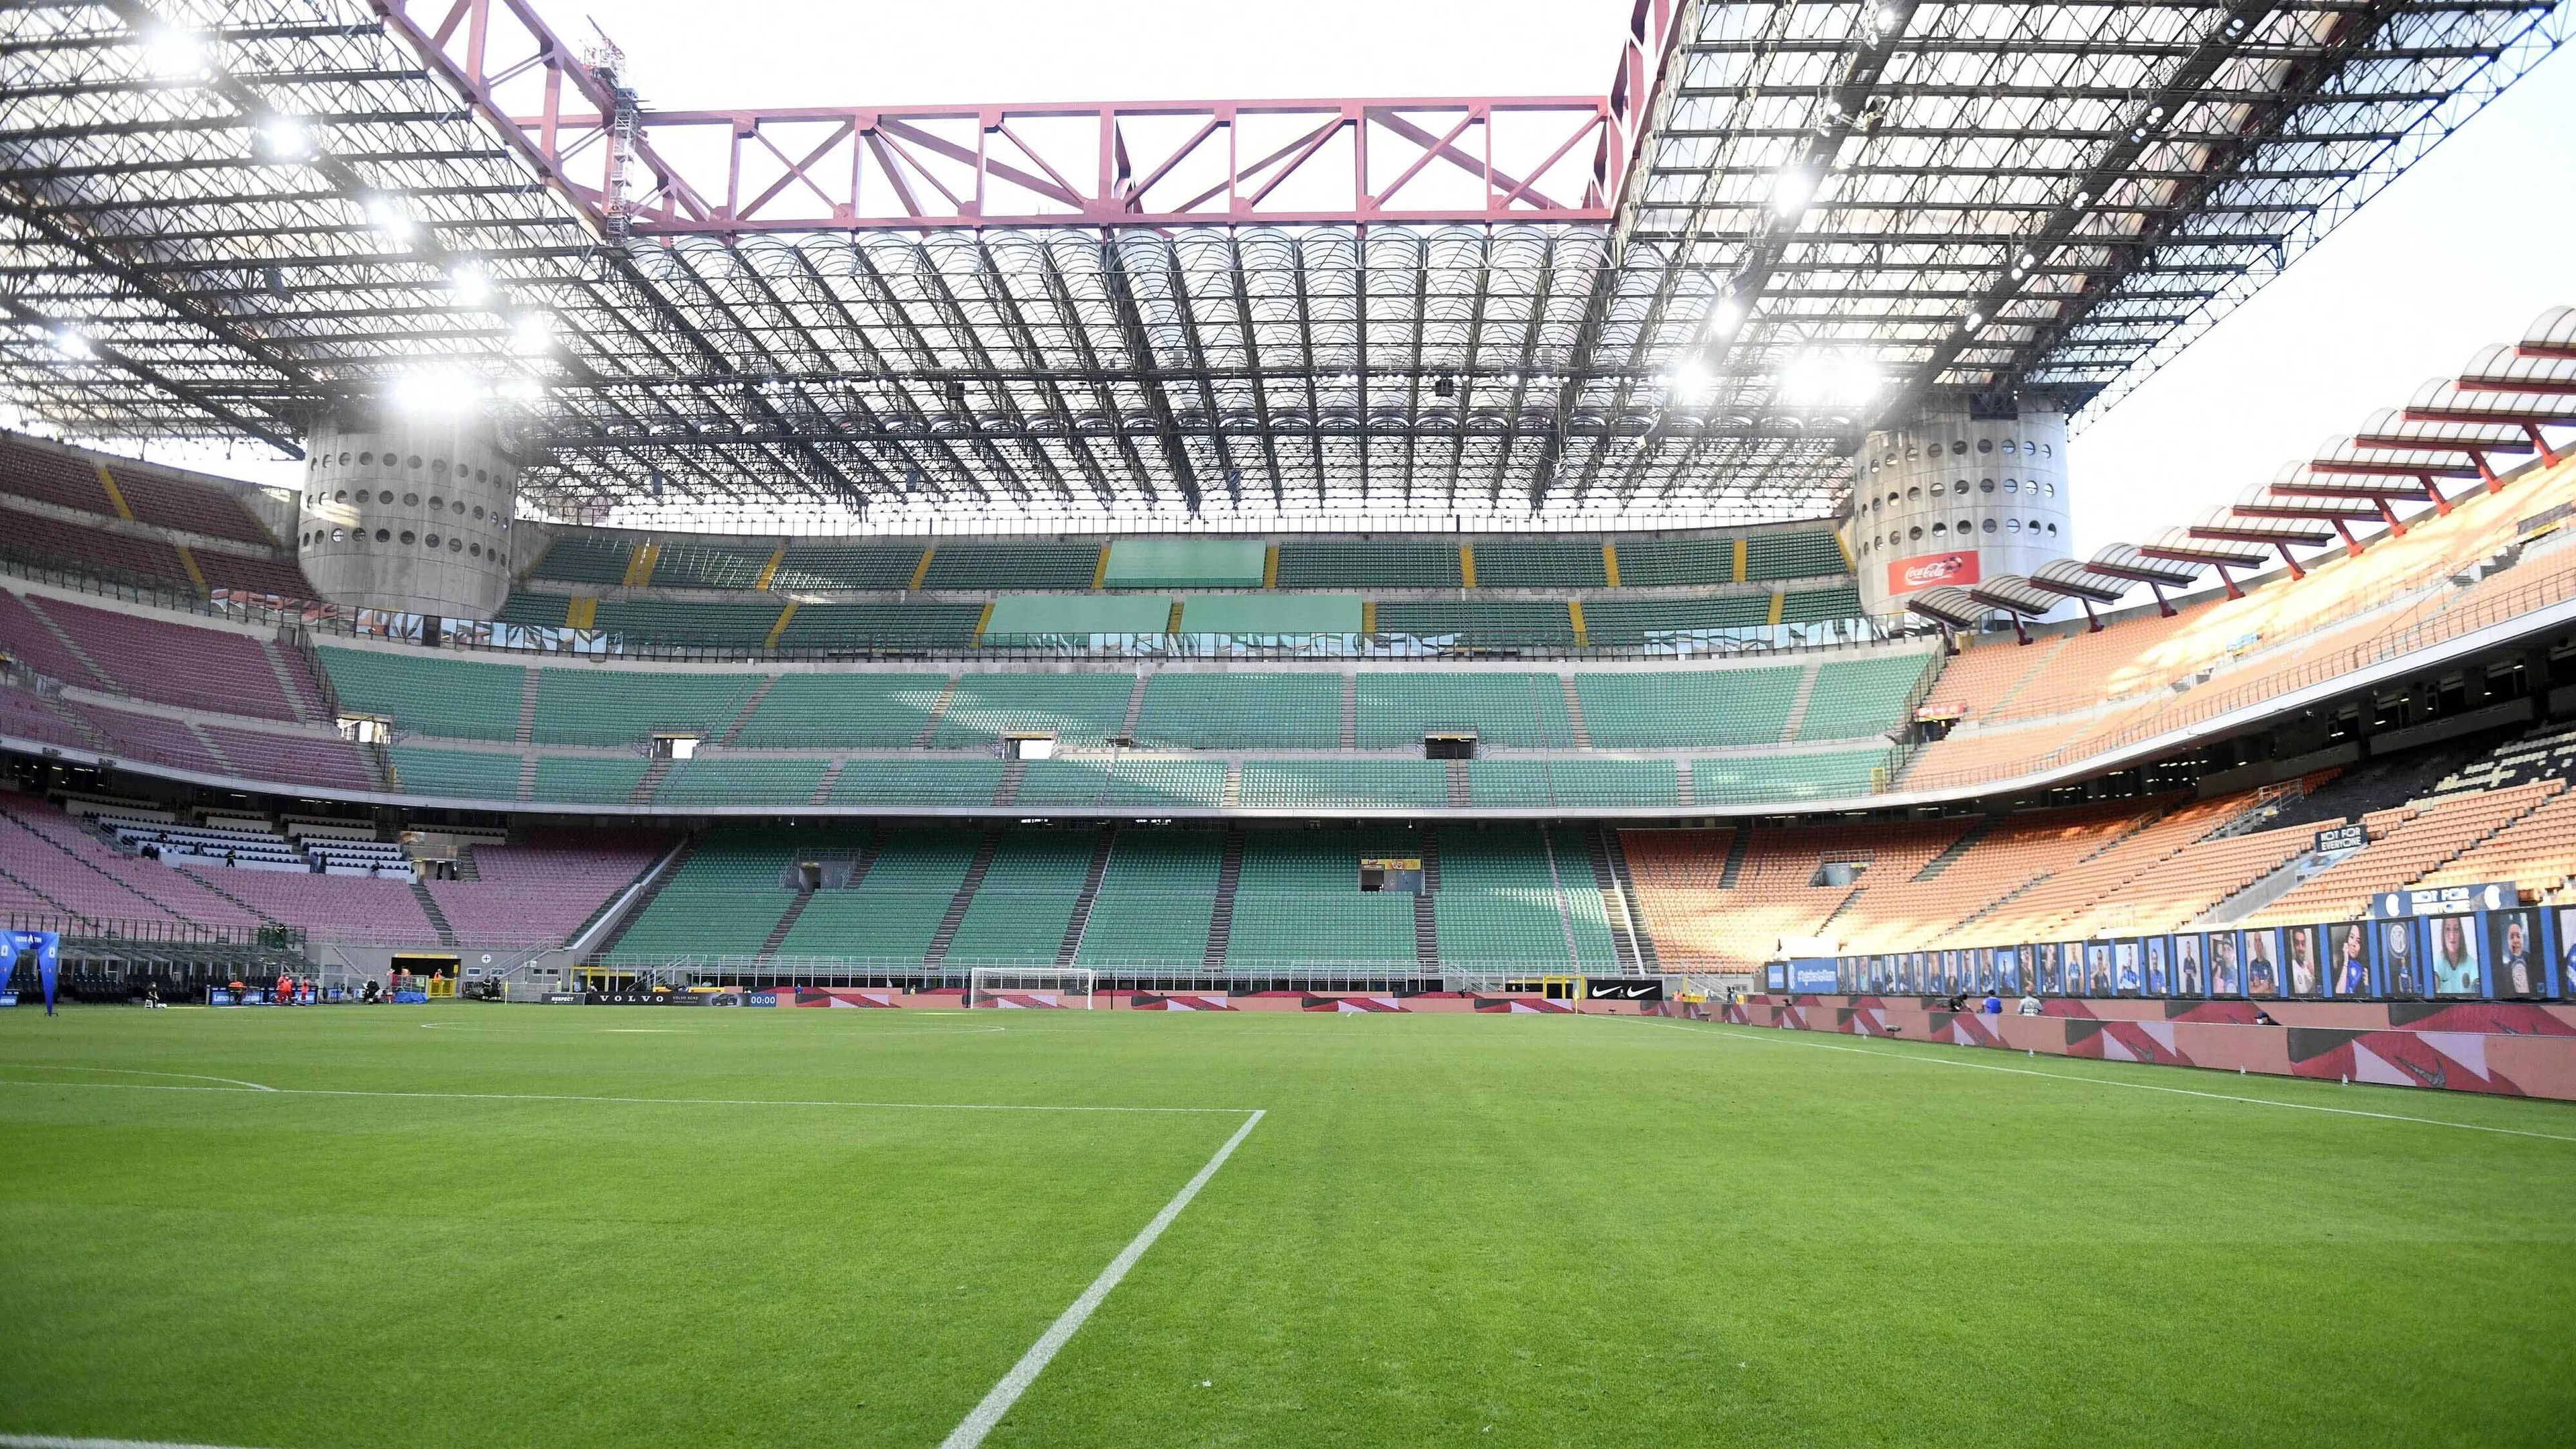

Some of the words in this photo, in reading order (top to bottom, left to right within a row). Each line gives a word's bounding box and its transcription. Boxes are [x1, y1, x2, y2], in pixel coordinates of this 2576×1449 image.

[2320, 830, 2339, 841] NOT
[2341, 826, 2361, 838] FOR
[2321, 836, 2361, 851] EVERYONE
[2411, 890, 2438, 903] NOT
[2441, 888, 2469, 901] FOR
[600, 995, 664, 1003] VOLVO
[751, 996, 775, 1004] 00:00
